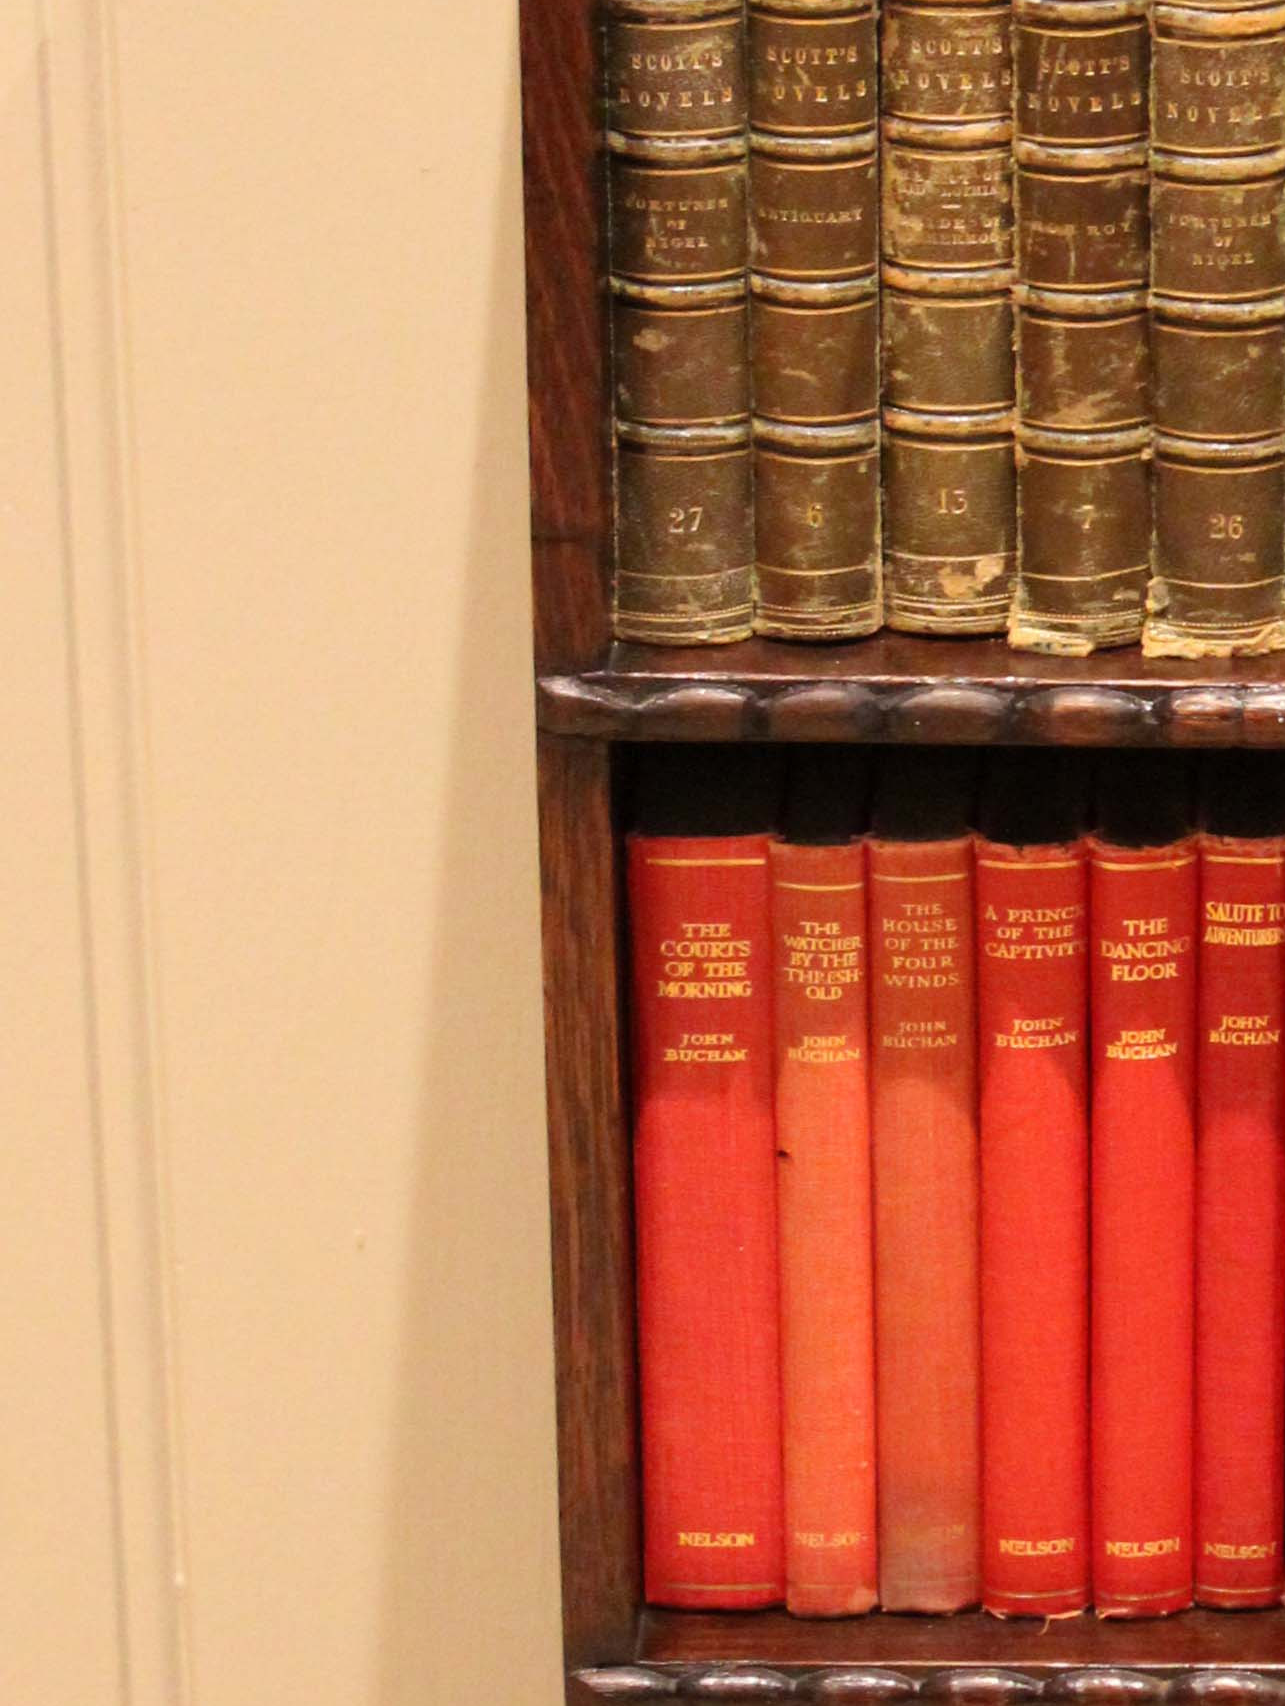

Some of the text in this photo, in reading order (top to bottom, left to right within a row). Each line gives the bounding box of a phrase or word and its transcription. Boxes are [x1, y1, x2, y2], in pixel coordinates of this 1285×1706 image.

[902, 904, 943, 915] THE
[986, 905, 997, 919] A
[682, 923, 731, 938] THE
[801, 922, 841, 935] THE
[883, 919, 957, 932] HOUSE
[997, 925, 1074, 940] OF THE
[1123, 919, 1168, 936] THE
[661, 941, 750, 957] COURTS
[784, 935, 862, 952] WATCHER
[884, 937, 959, 950] OF THE
[791, 953, 858, 967] BY THE
[892, 956, 954, 969] FOUR
[666, 962, 746, 977] OF THE
[1112, 963, 1178, 981] FLOOR
[883, 974, 959, 989] WINDS
[658, 981, 751, 998] MORNING
[806, 986, 842, 1000] OLD
[1012, 1018, 1064, 1033] JOHN
[1220, 1015, 1269, 1030] JOHN
[681, 1034, 734, 1045] JOHN
[801, 1036, 847, 1048] JOHN
[996, 1031, 1078, 1047] BUCHAN
[1116, 1030, 1165, 1044] JOHN
[1209, 1030, 1280, 1045] BUCHAN
[664, 1049, 747, 1062] BUCHAN
[1107, 1043, 1177, 1059] BUCHAN
[679, 1532, 753, 1547] NELSON
[1000, 1537, 1074, 1555] NELSON
[1106, 1538, 1179, 1557] NELSON
